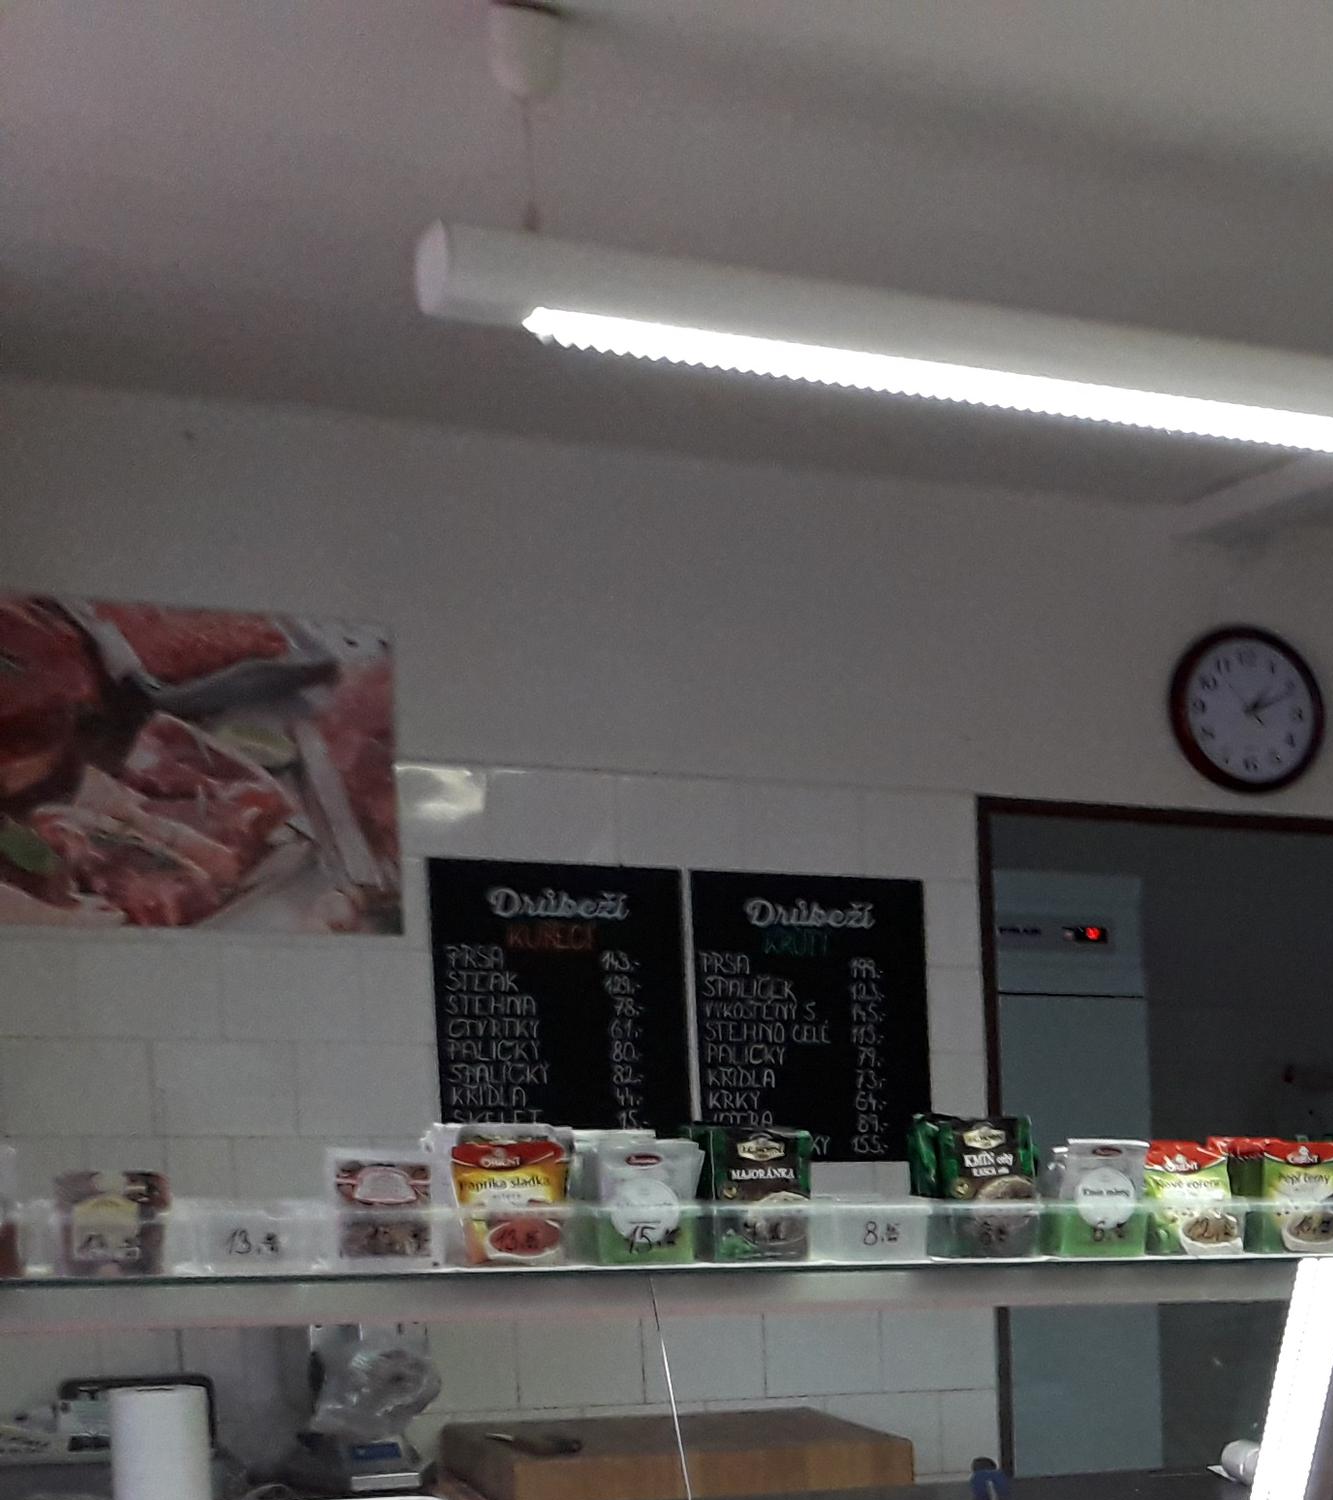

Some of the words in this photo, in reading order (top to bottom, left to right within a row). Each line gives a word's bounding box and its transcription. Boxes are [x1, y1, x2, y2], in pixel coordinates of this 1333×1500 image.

[486, 887, 630, 921] Drůbeží
[744, 897, 876, 930] Drůbeží
[447, 944, 504, 970] PRSA
[700, 952, 750, 975] PRSA
[446, 971, 519, 992] STEAK
[446, 994, 537, 1016] STEHNA
[704, 1022, 785, 1044] STEHNO
[707, 1090, 761, 1111] KRKY
[730, 1167, 796, 1181] MAJORÁNKA
